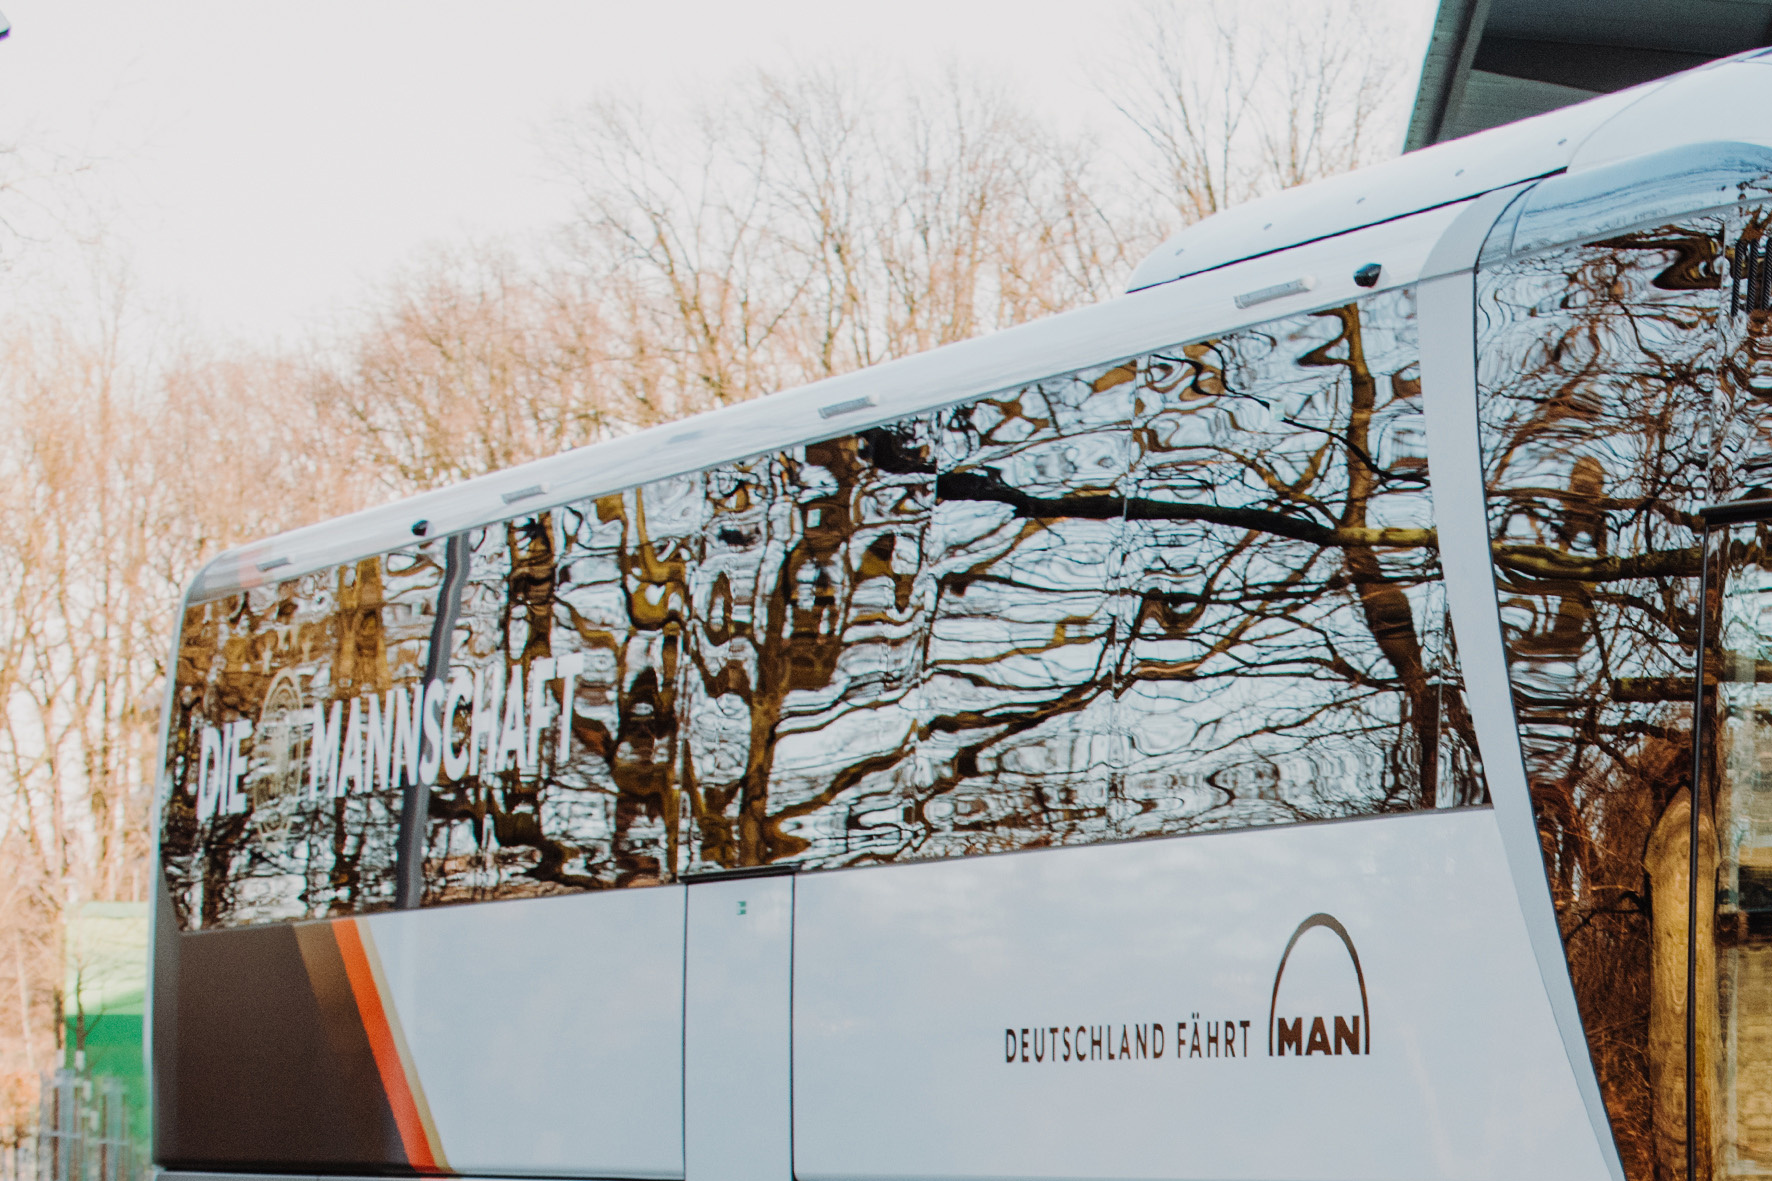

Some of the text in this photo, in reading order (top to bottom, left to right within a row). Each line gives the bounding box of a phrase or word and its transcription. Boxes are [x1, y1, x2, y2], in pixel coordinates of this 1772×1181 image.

[197, 652, 583, 821] DIE MANNSCHAFT
[1004, 1012, 1361, 1064] DEUTSCHLAND FÄHRT MAN
